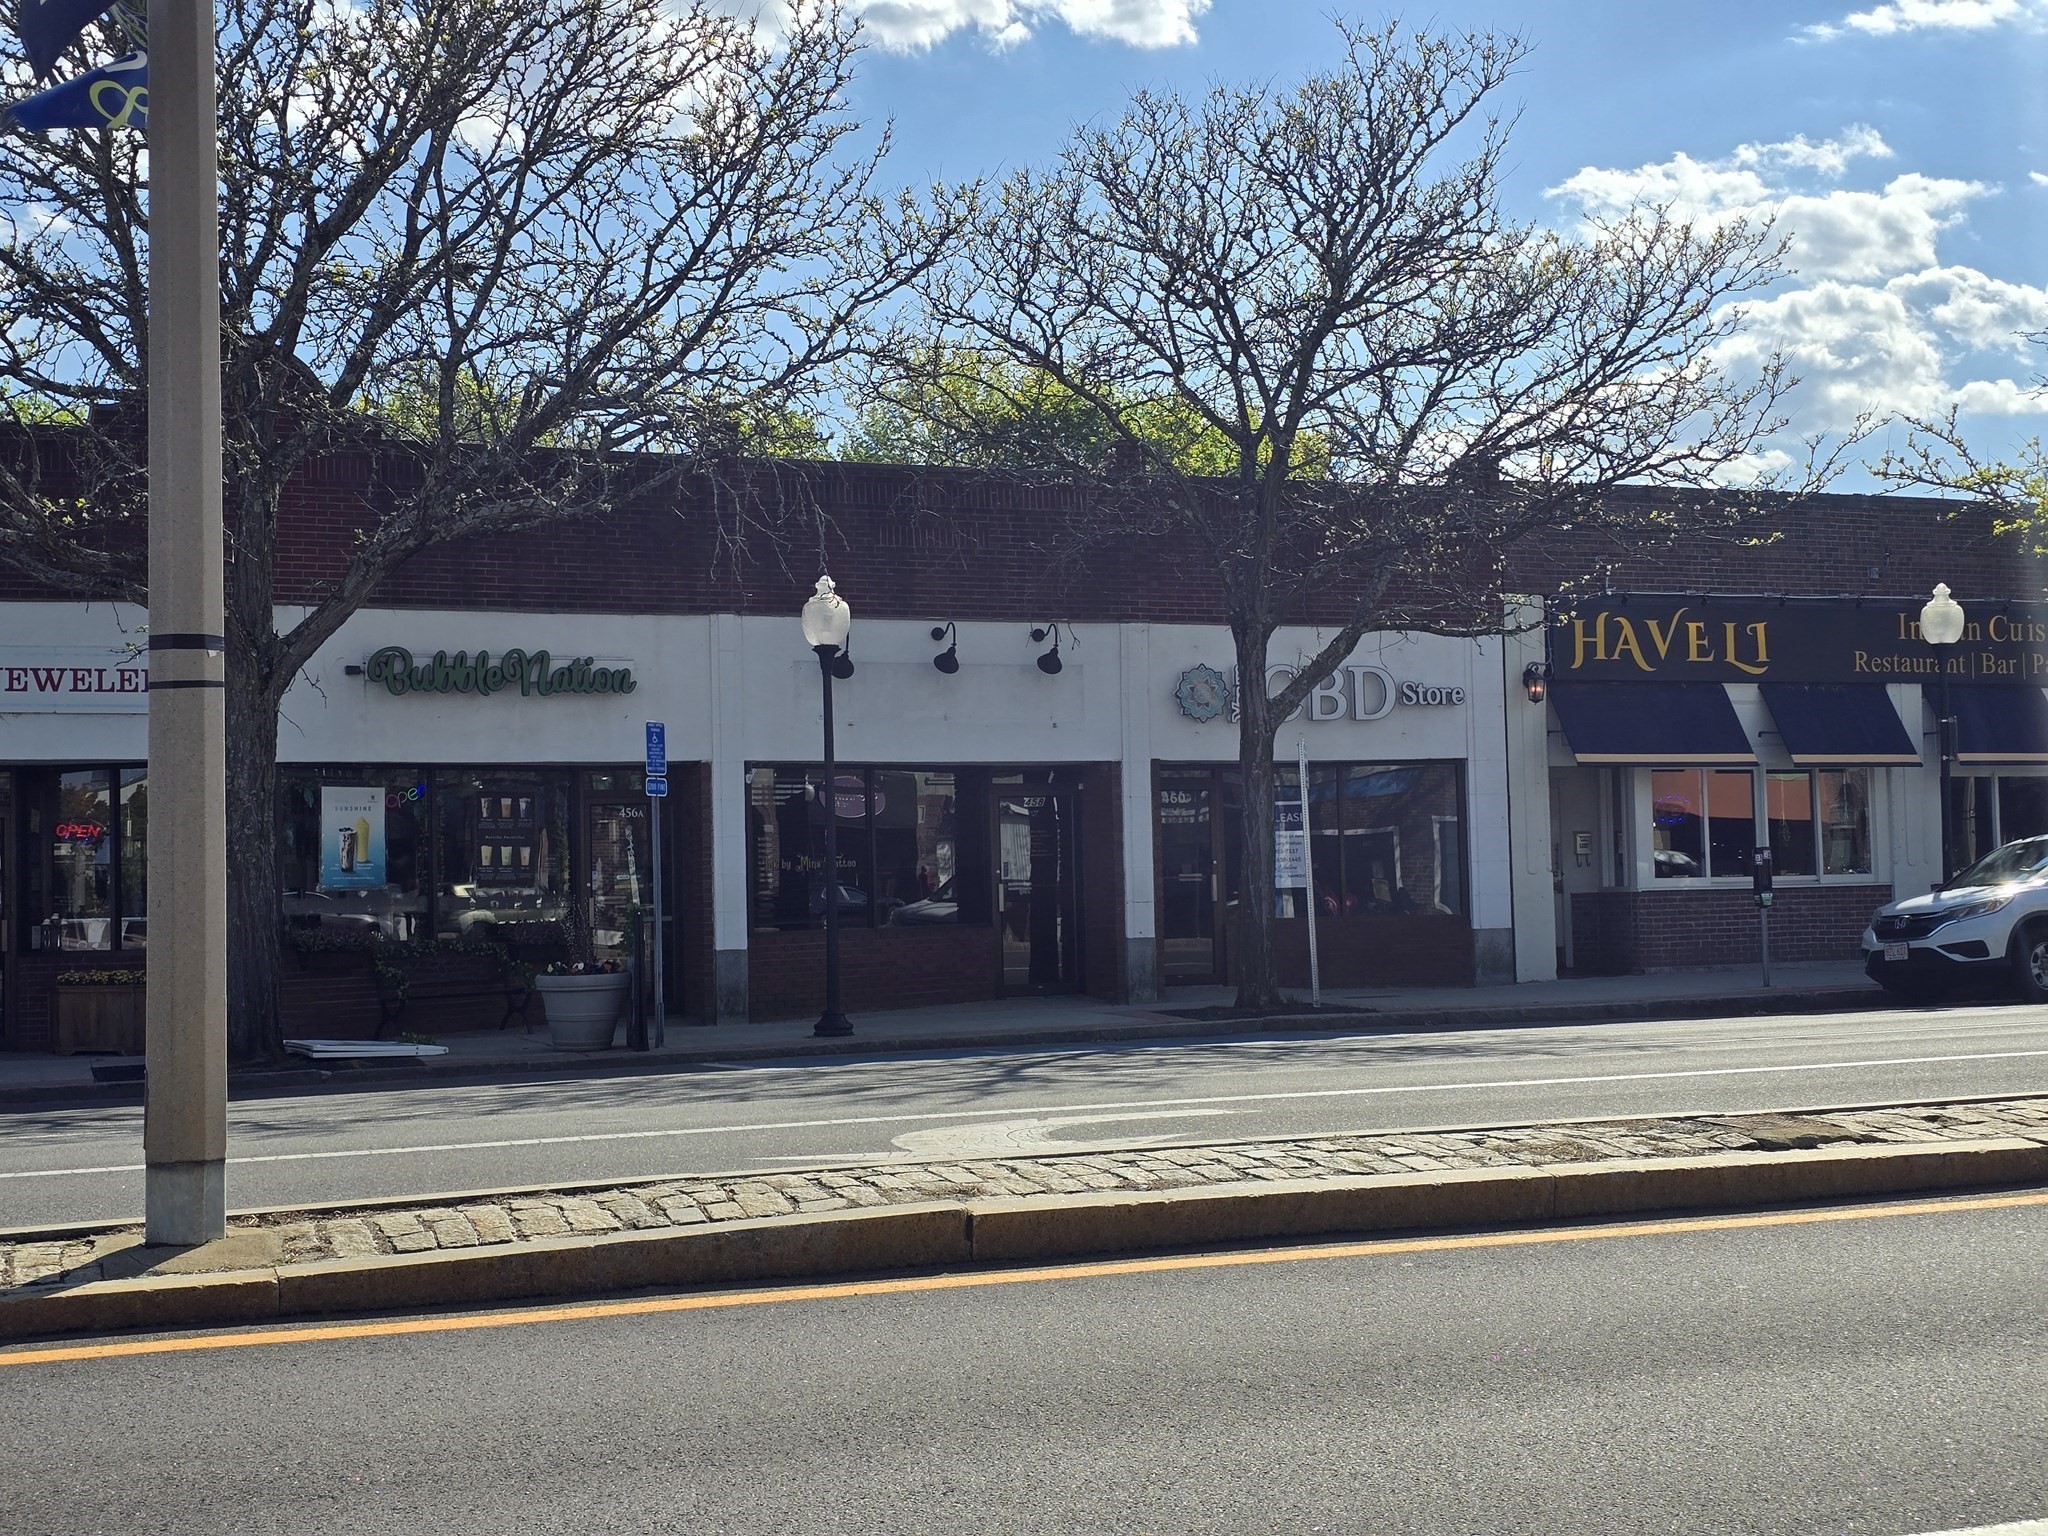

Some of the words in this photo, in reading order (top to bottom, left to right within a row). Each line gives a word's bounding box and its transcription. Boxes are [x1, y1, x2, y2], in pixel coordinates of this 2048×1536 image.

[1897, 613, 1981, 642] Inn
[1570, 607, 1771, 675] HAVELI
[366, 645, 506, 697] Bubble
[500, 647, 638, 697] Nation
[1980, 652, 2017, 675] Bar
[2032, 653, 2048, 675] P
[0, 667, 148, 693] EWELE
[1265, 664, 1397, 722] CBD
[1400, 681, 1466, 706] Store
[1024, 797, 1045, 807] 458
[1160, 791, 1186, 804] 460
[619, 807, 644, 818] 456A
[55, 822, 101, 838] OPEN
[781, 858, 791, 871] by
